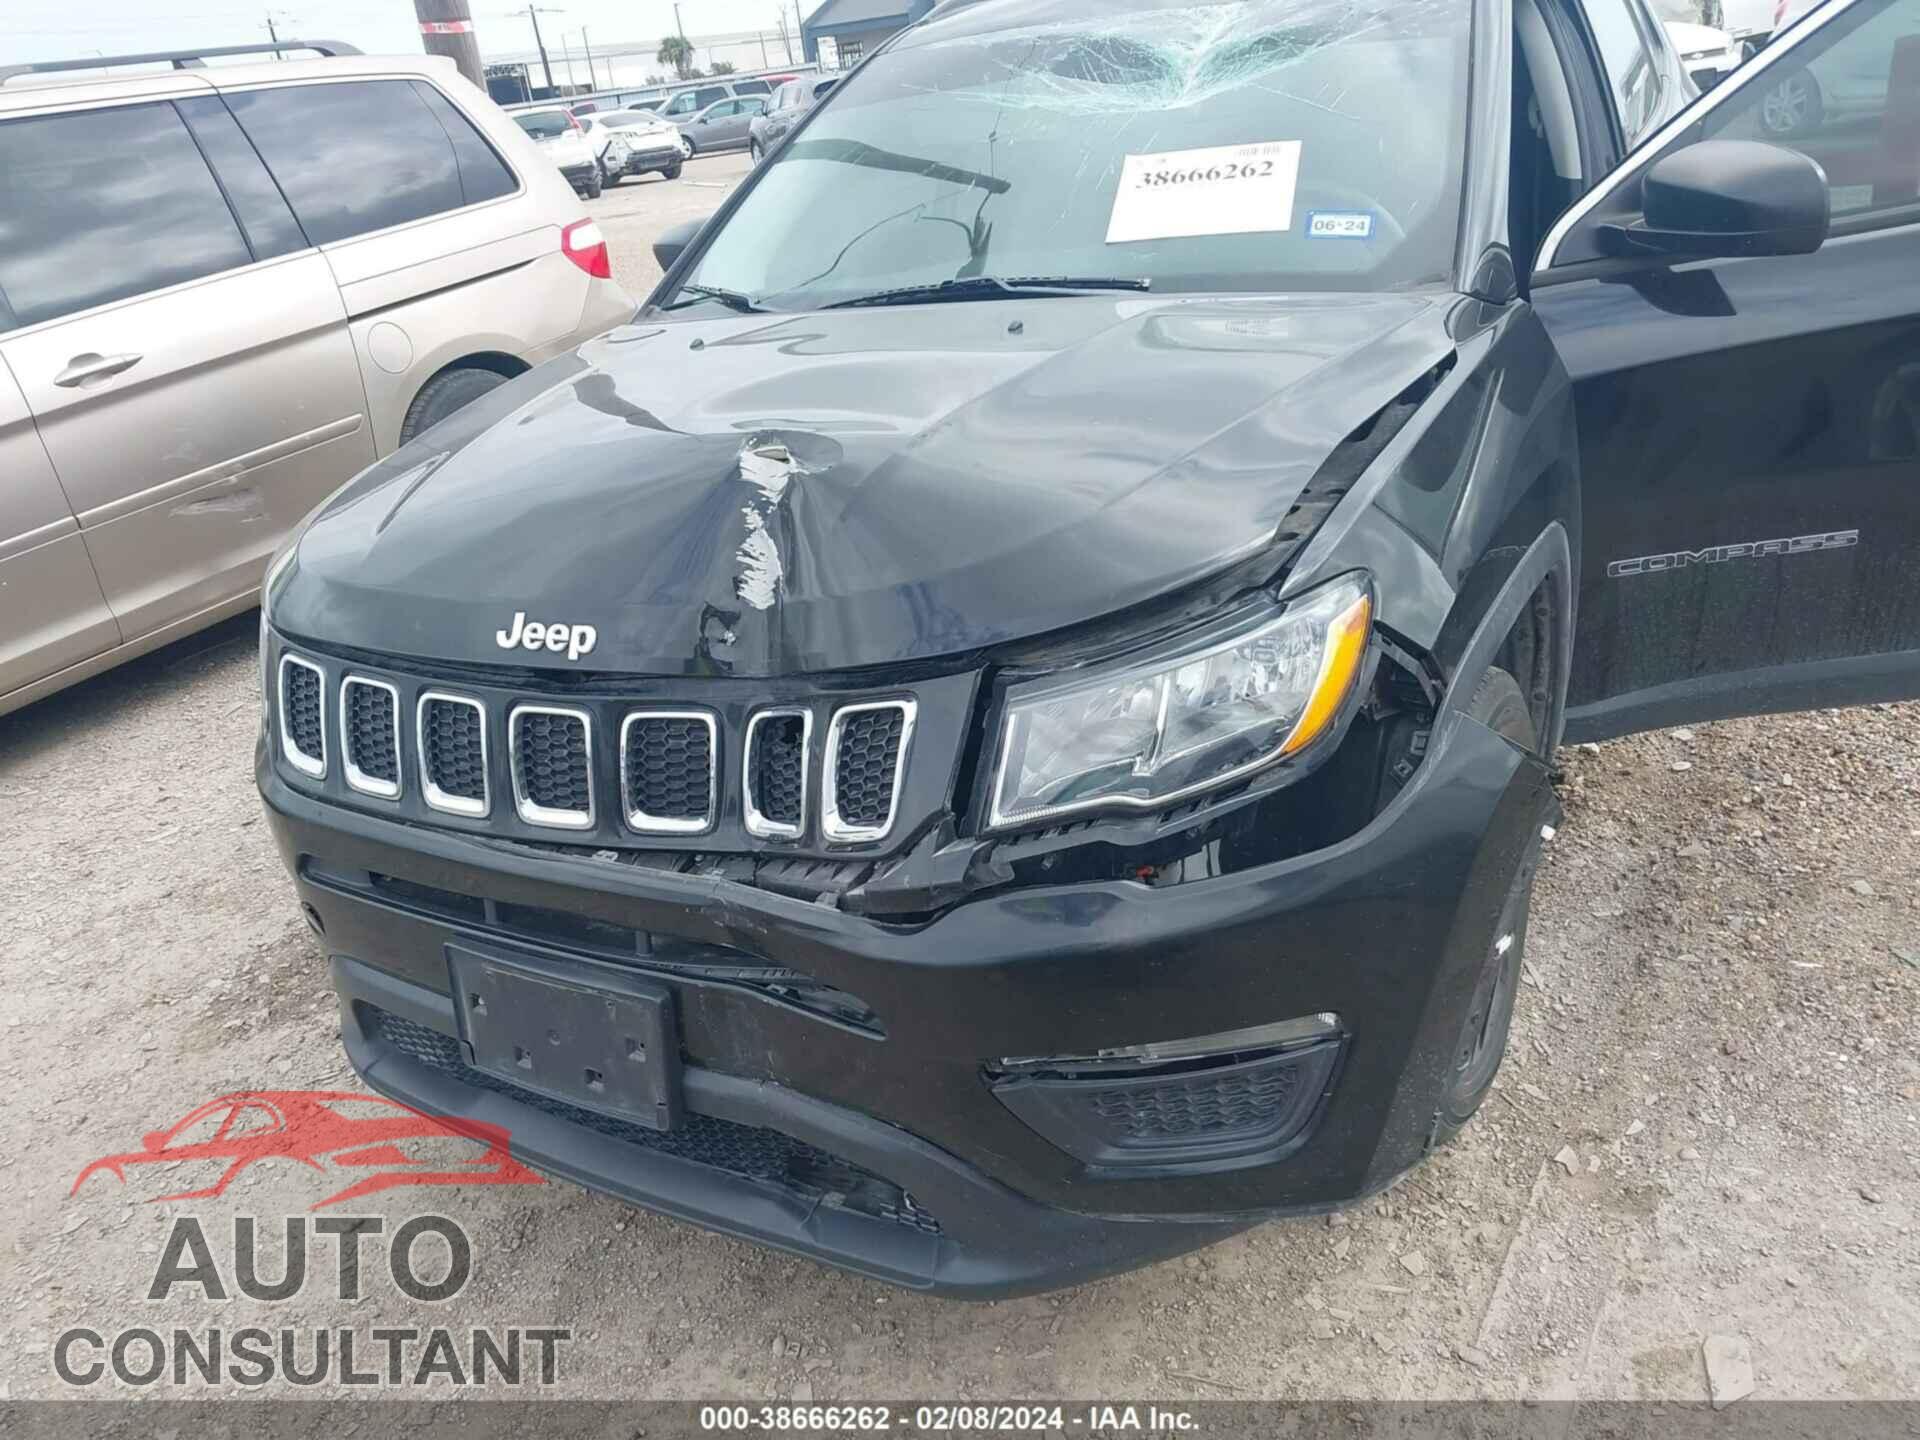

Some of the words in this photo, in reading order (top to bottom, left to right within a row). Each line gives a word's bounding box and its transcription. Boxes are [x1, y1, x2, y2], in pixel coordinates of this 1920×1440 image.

[1135, 160, 1274, 189] 38666262
[1607, 529, 1860, 577] COMPASS
[495, 611, 597, 661] Jeep
